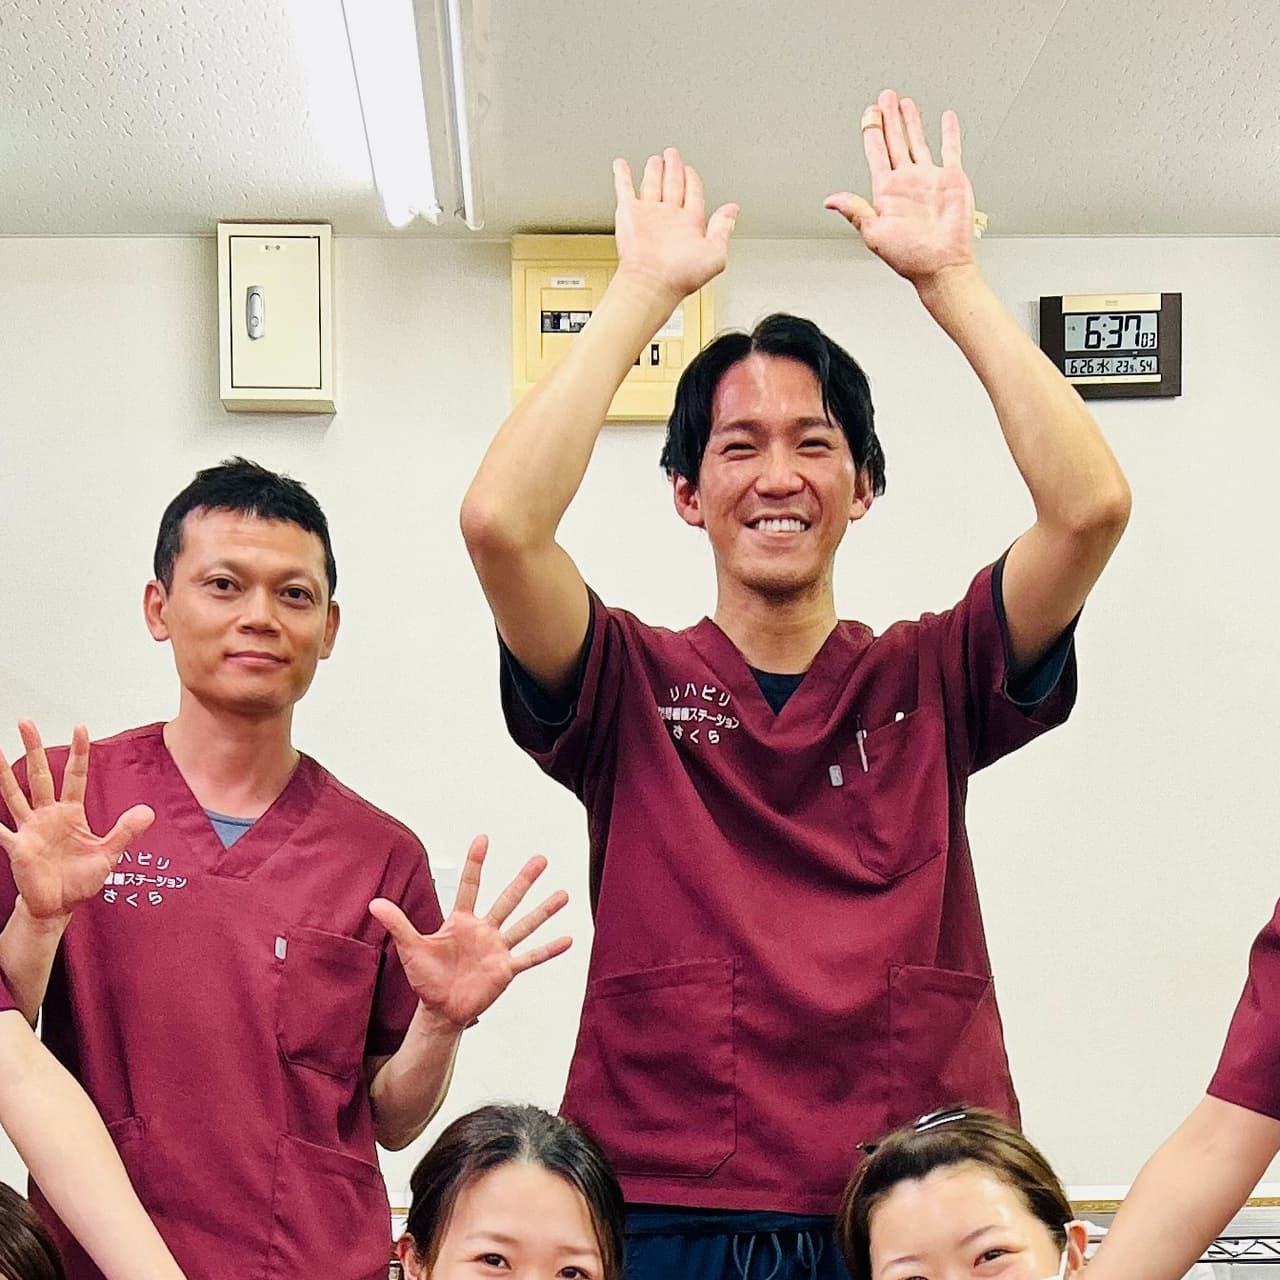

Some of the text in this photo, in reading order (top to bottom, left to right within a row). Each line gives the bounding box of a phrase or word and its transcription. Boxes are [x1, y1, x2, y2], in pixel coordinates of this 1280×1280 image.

[1084, 315, 1141, 349] 6:37
[670, 683, 731, 706] リハビリ
[673, 724, 720, 744] さくら
[117, 851, 170, 870] ハビリ
[103, 889, 163, 907] さくら
